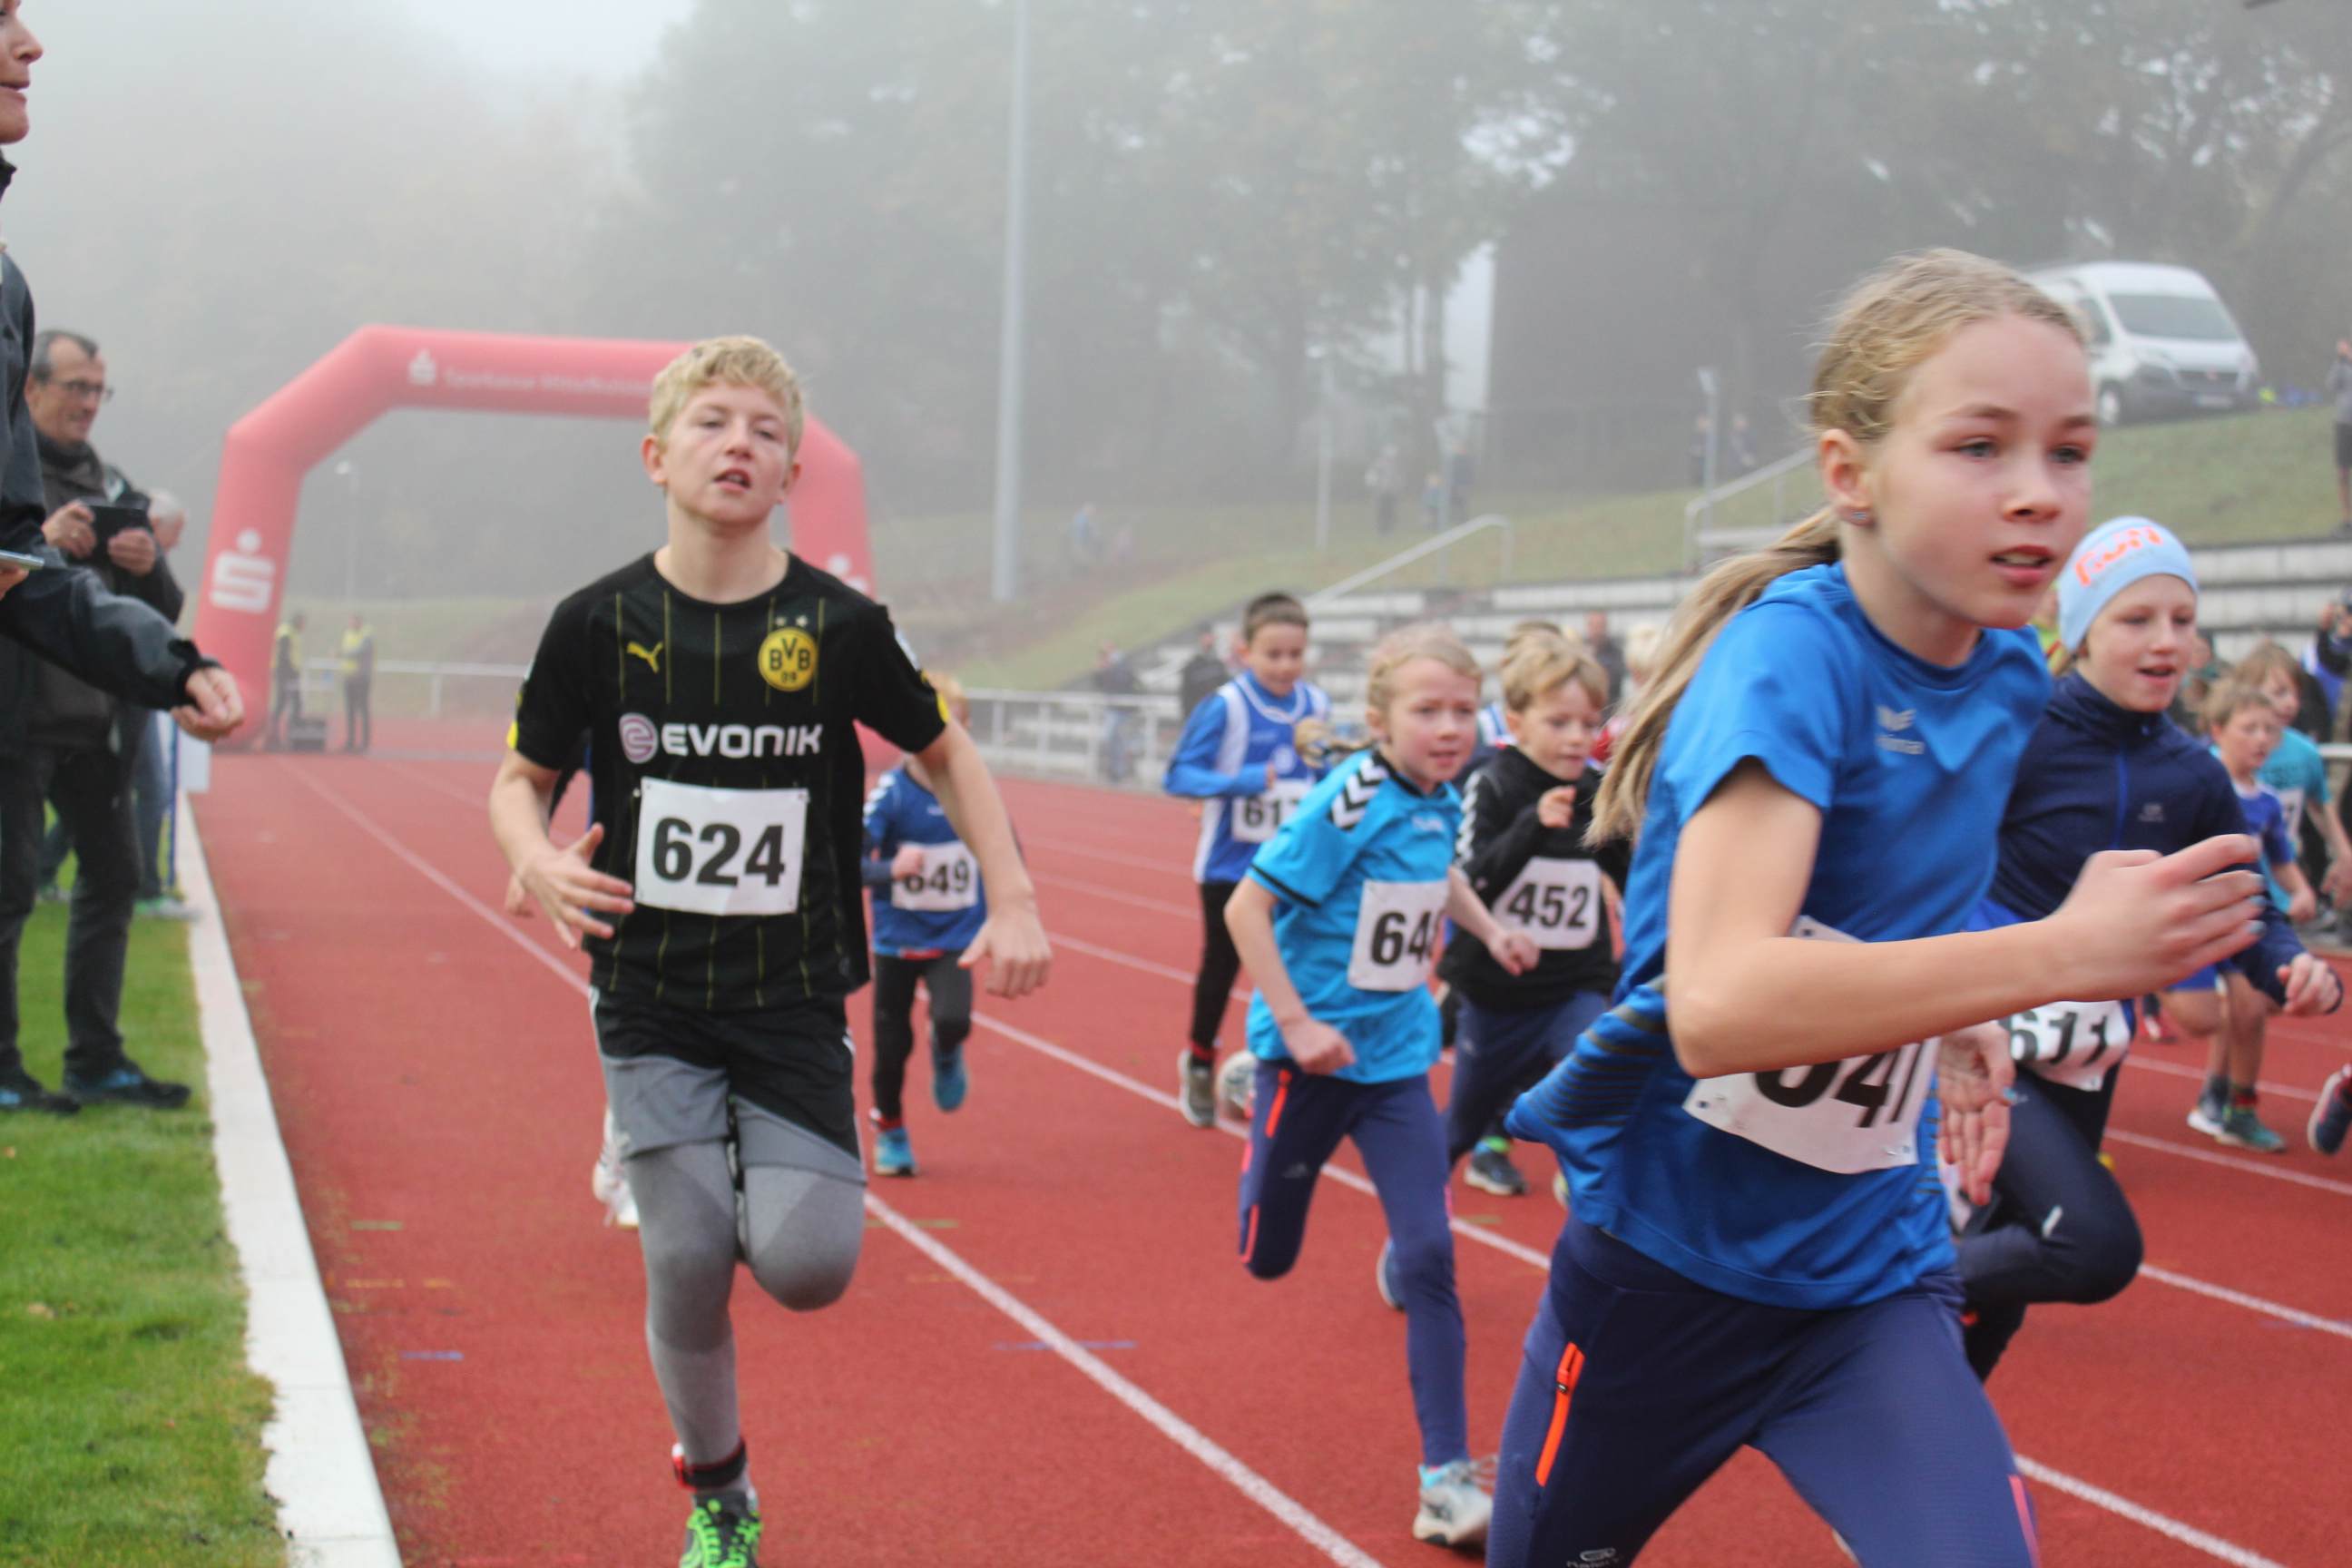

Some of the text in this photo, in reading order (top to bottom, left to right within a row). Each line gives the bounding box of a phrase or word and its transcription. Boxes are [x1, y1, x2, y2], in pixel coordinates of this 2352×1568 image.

[769, 637, 810, 671] BVB
[662, 723, 823, 758] EVONIK
[1244, 795, 1300, 828] 61
[652, 817, 786, 887] 624
[1507, 881, 1589, 928] 452
[1999, 1009, 2108, 1067] 611
